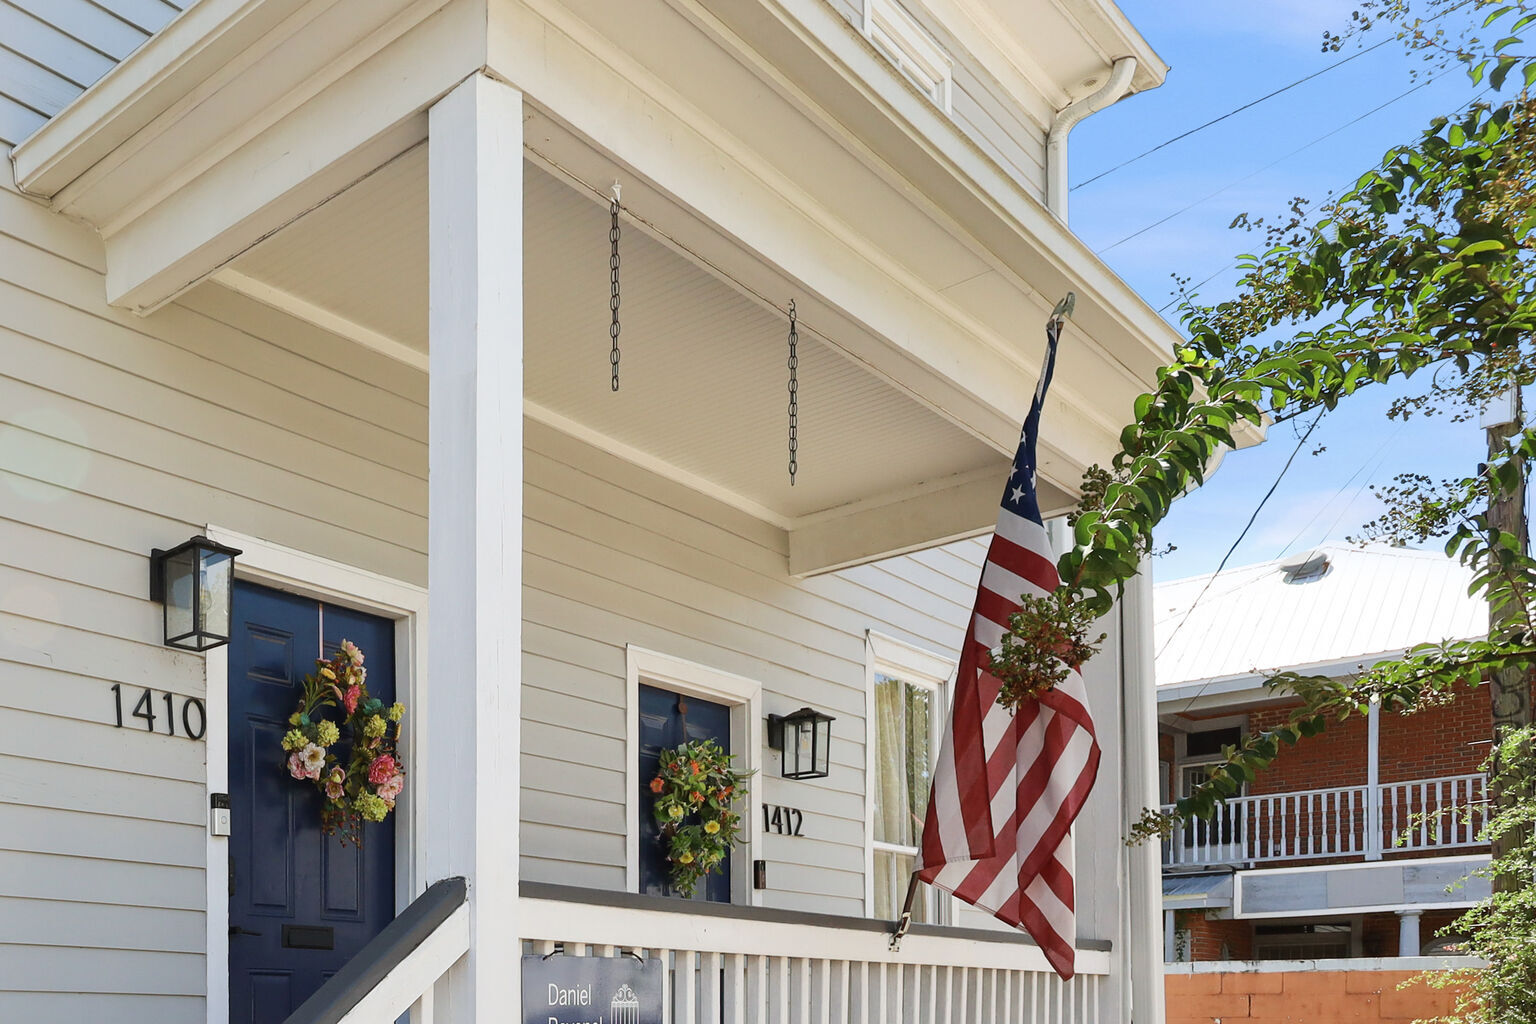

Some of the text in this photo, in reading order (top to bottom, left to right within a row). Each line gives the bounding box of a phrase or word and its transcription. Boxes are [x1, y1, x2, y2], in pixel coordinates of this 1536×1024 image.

[111, 683, 206, 740] 1410
[761, 803, 805, 837] 1412
[548, 983, 592, 1006] Daniel
